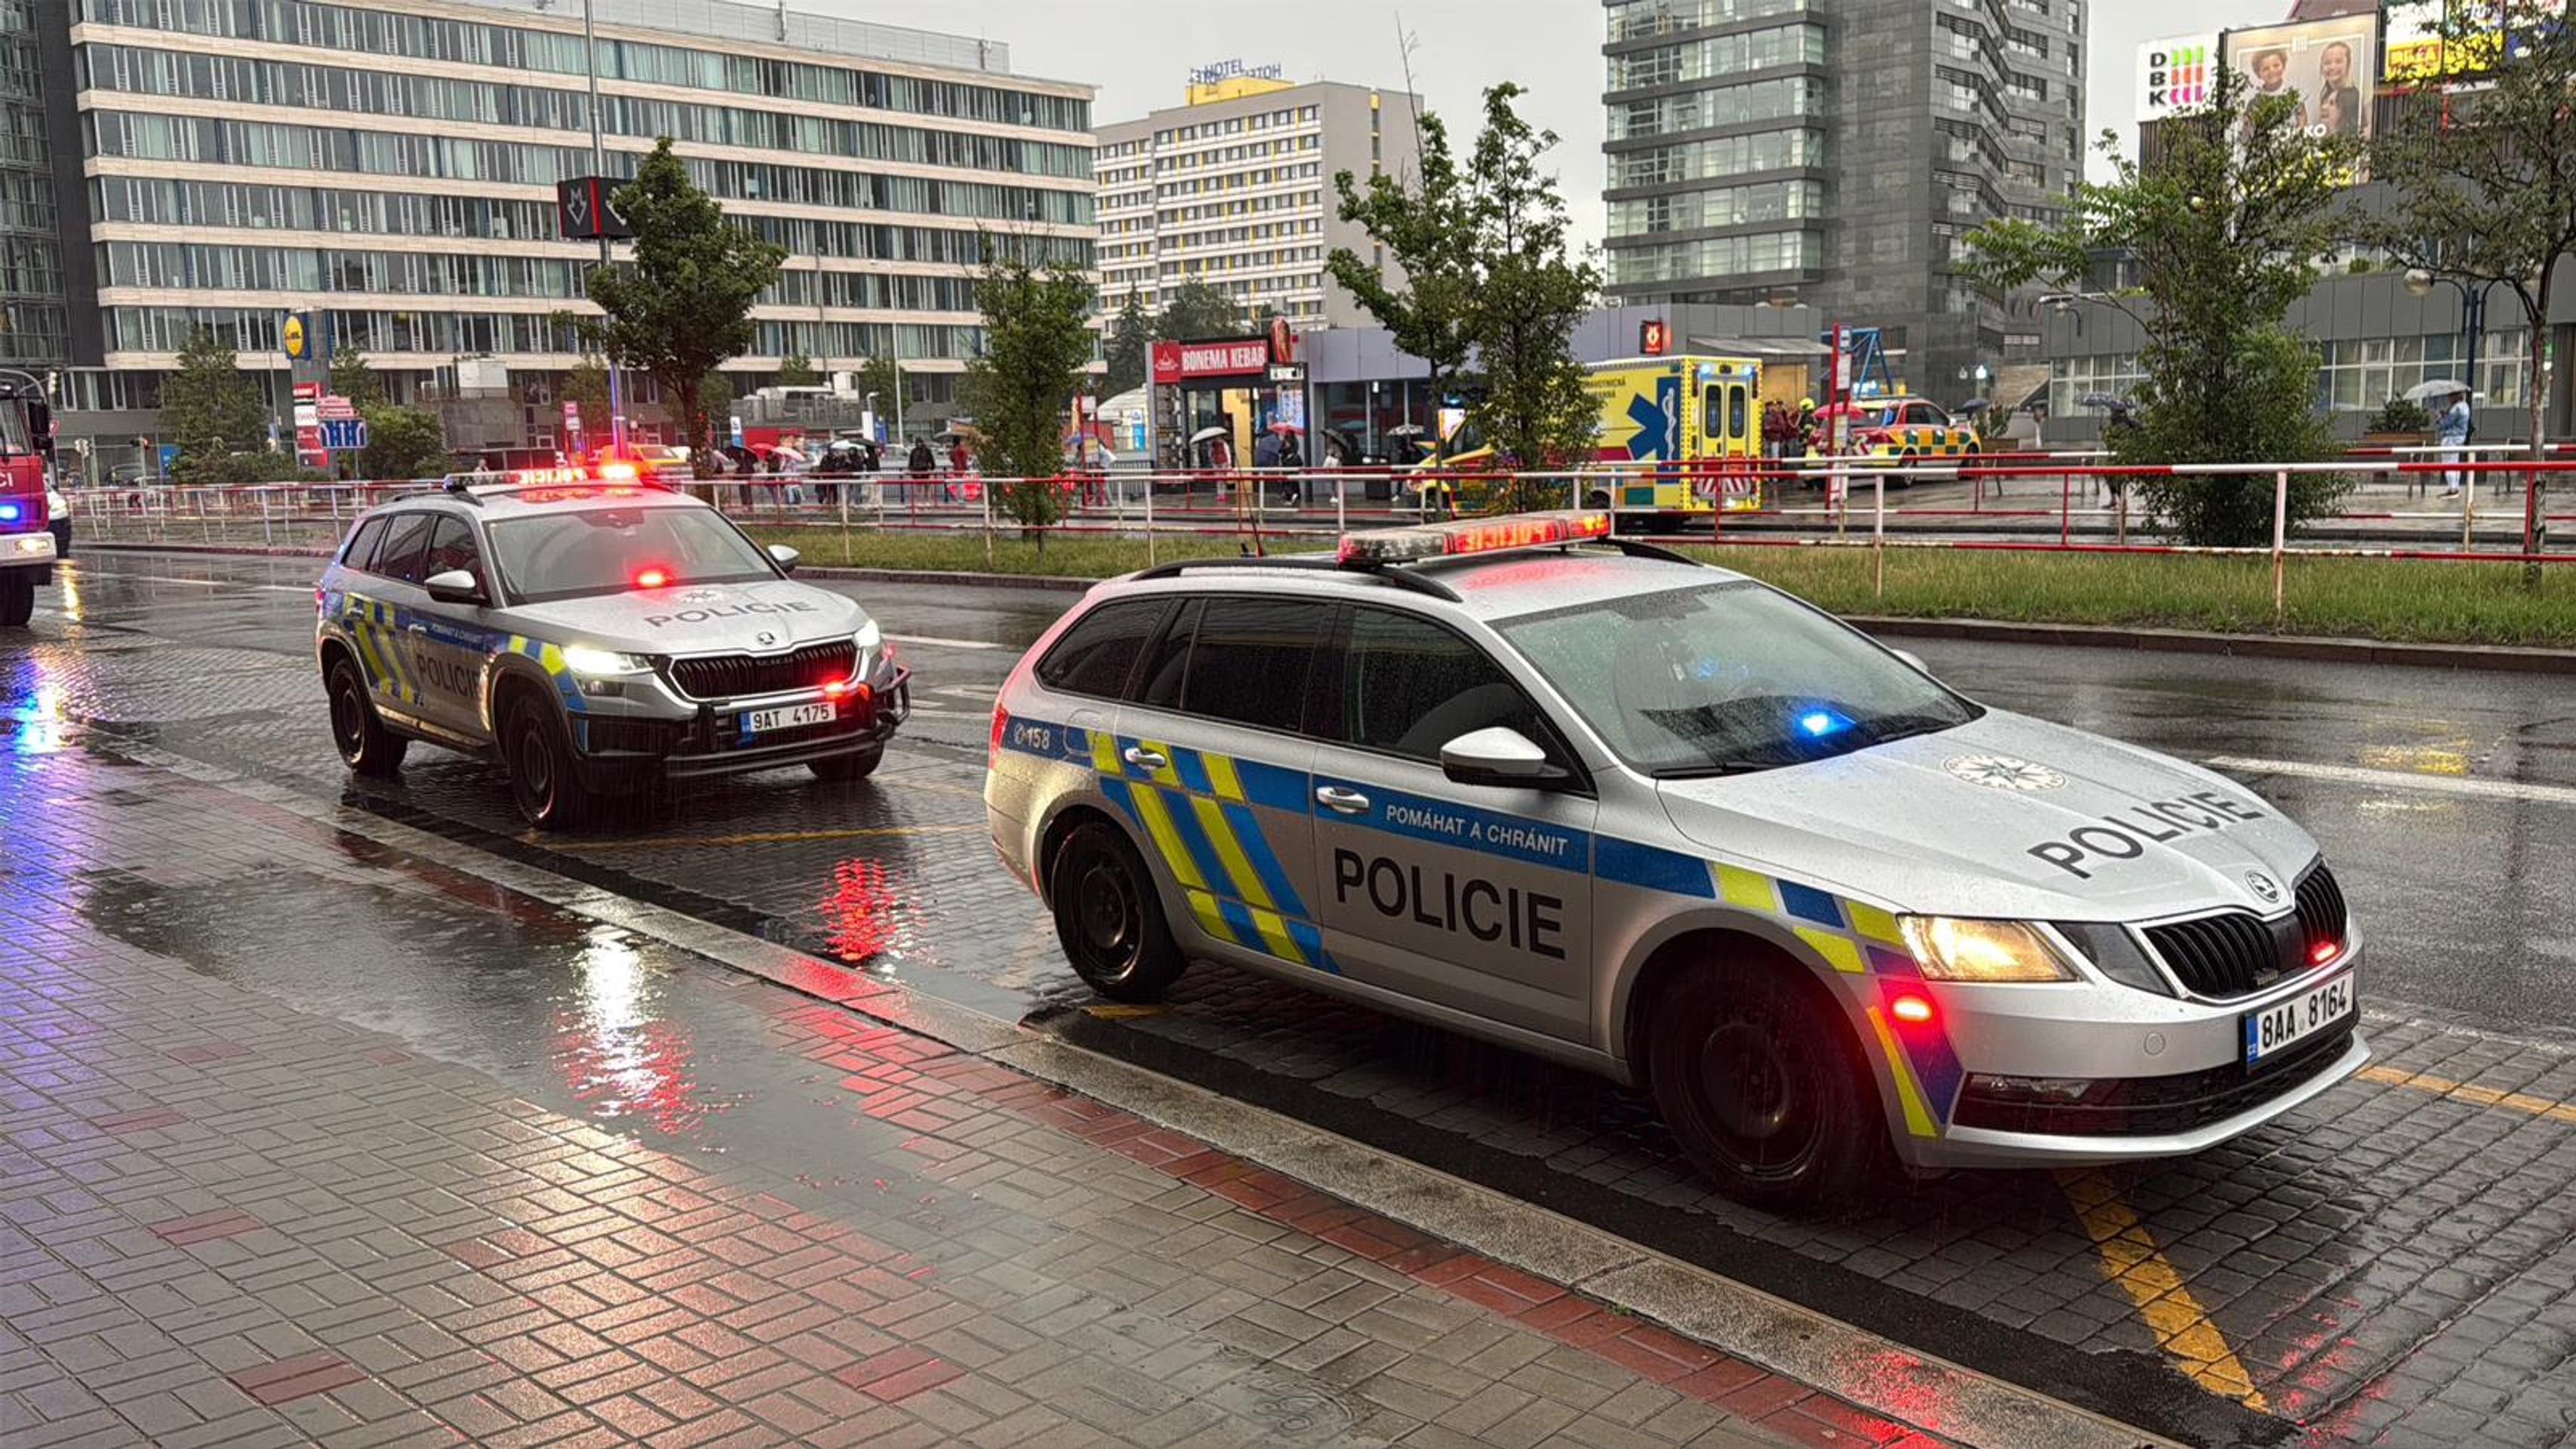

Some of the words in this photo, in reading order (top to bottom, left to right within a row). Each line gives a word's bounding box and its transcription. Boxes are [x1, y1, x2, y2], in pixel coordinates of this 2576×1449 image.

[1205, 59, 1245, 78] HOTEL
[1182, 349, 1227, 371] BONEMA
[1230, 346, 1265, 368] KEBAB
[645, 601, 819, 627] POLICIE
[754, 712, 780, 730] 9AT
[793, 703, 829, 722] 4175
[1026, 728, 1051, 751] 158
[1386, 804, 1466, 835] POMÁHAT
[1470, 823, 1482, 839] A
[1487, 824, 1568, 856] CHRÁNIT
[2027, 792, 2264, 879] POLICIE
[1334, 848, 1565, 960] POLICIE
[2262, 1004, 2296, 1048] 8AA
[2308, 980, 2347, 1028] 8164
